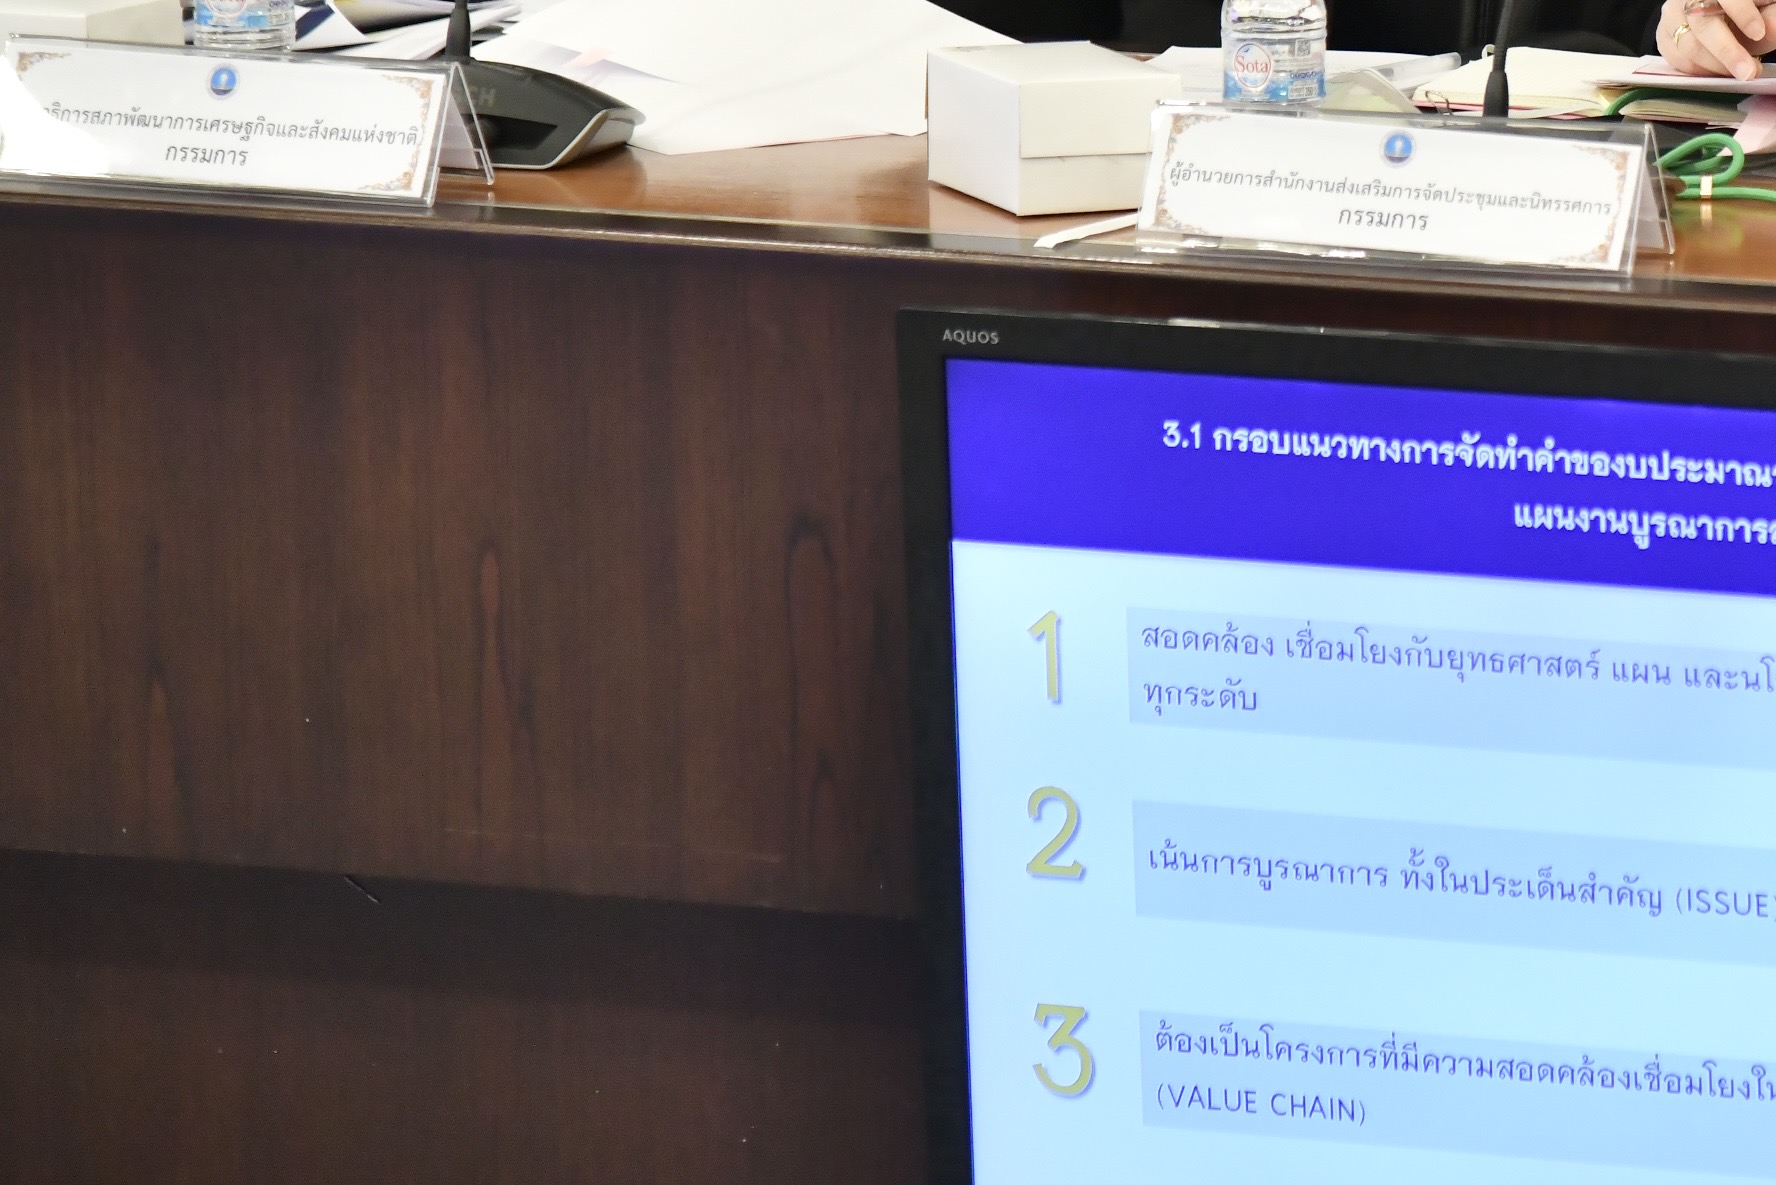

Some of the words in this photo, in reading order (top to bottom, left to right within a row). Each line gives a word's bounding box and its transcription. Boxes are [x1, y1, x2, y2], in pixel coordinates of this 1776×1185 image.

[1235, 55, 1269, 74] Sota
[165, 145, 249, 166] กรรมการ
[1169, 161, 1612, 216] ผู้อำนวยการสำนักงานส่งเสริมการจัดประชุมและนิทรรศการ
[1338, 208, 1429, 231] กรรมการ
[942, 328, 1000, 346] AQUOS
[1162, 420, 1202, 450] 3.1
[1026, 609, 1062, 704] 1
[1141, 621, 1275, 657] สอดคล้อง
[1286, 620, 1601, 683] เชื่อมโยงกับยุทธศาสตร์
[1612, 660, 1672, 686] แผน
[1143, 677, 1258, 717] ทุกระดับ
[1025, 785, 1086, 880] 2
[1148, 837, 1389, 891] เน้นการบูรณาการ
[1400, 847, 1662, 917] ทั้งในประเด็นสำคัญ
[1031, 1002, 1096, 1098] 3
[1156, 1083, 1257, 1115] (VALUE
[1270, 1092, 1367, 1127] CHAIN)
